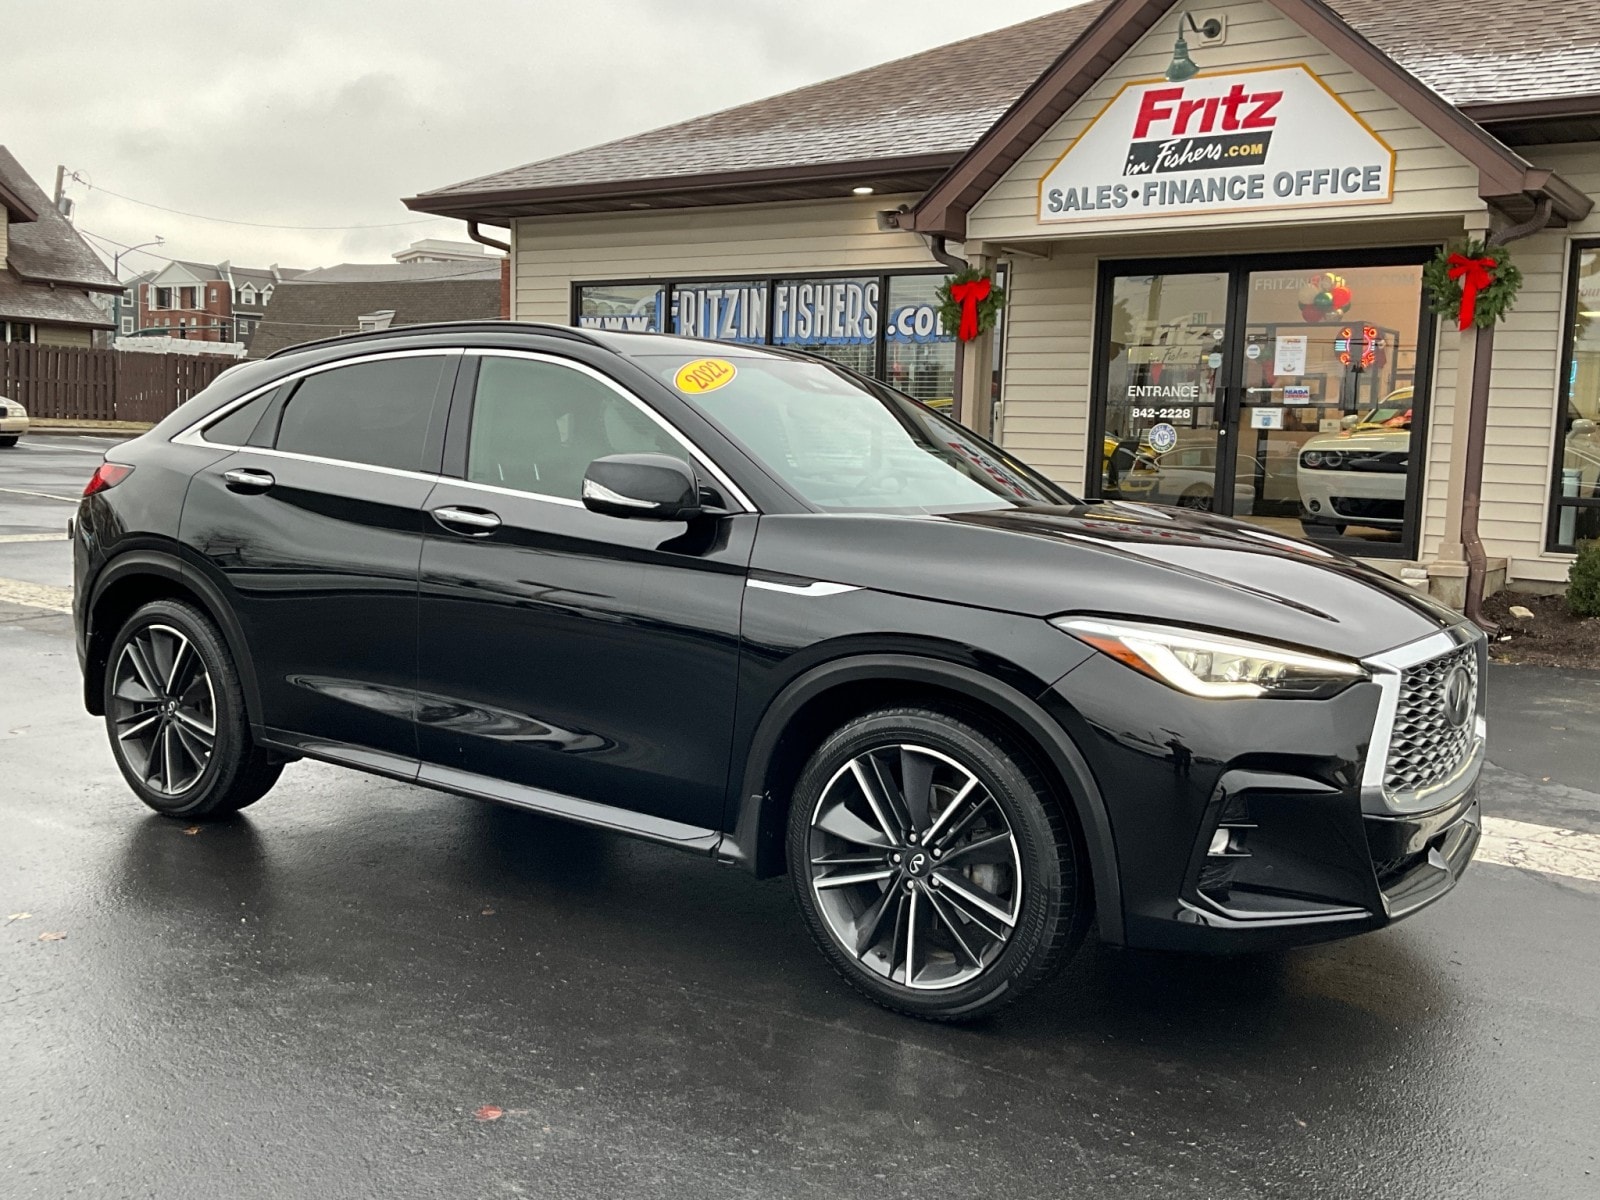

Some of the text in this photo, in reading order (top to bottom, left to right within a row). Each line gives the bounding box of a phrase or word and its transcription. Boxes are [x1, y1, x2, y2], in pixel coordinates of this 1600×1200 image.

[1132, 84, 1283, 138] Fritz
[1126, 157, 1150, 176] in
[1273, 165, 1382, 198] OFFICE
[685, 361, 729, 389] 2022
[1127, 385, 1199, 397] ENTRANCE
[1132, 408, 1191, 419] 842-2228
